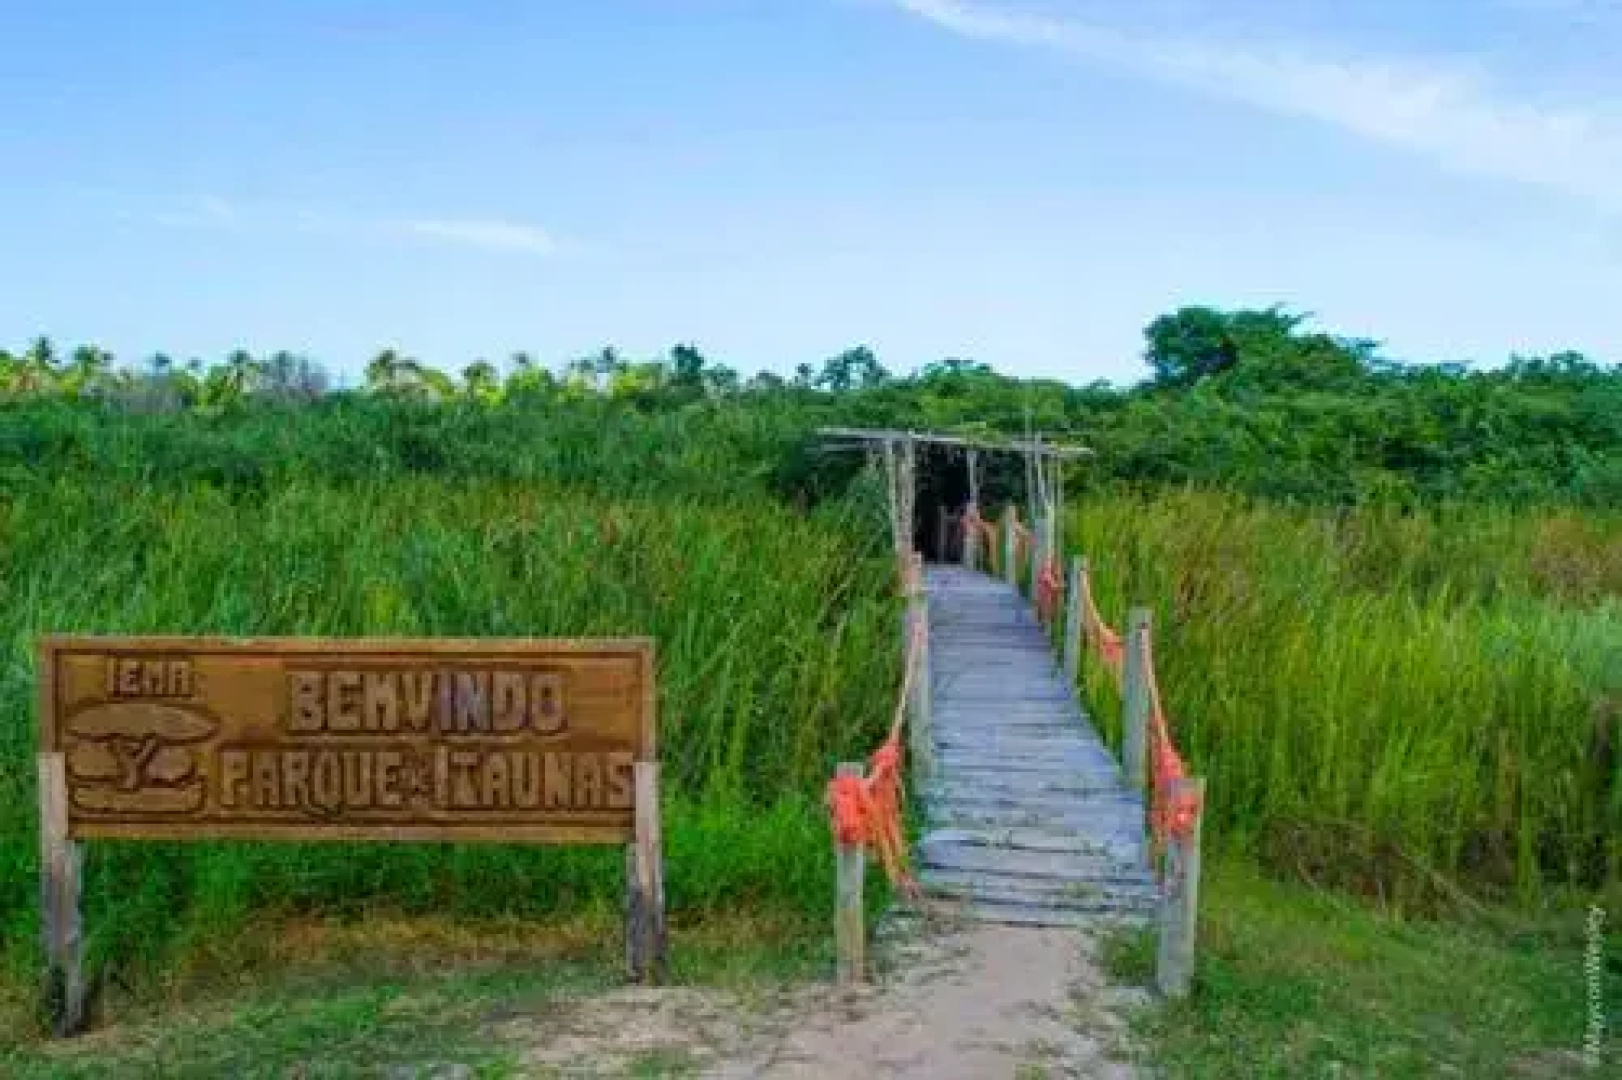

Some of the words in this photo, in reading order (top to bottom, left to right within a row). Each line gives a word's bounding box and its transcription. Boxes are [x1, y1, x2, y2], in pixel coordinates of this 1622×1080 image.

[107, 657, 191, 694] IEMA
[287, 671, 566, 732] BEMVINDO
[221, 750, 401, 811] PARQUE
[434, 746, 634, 808] ITAUNAS
